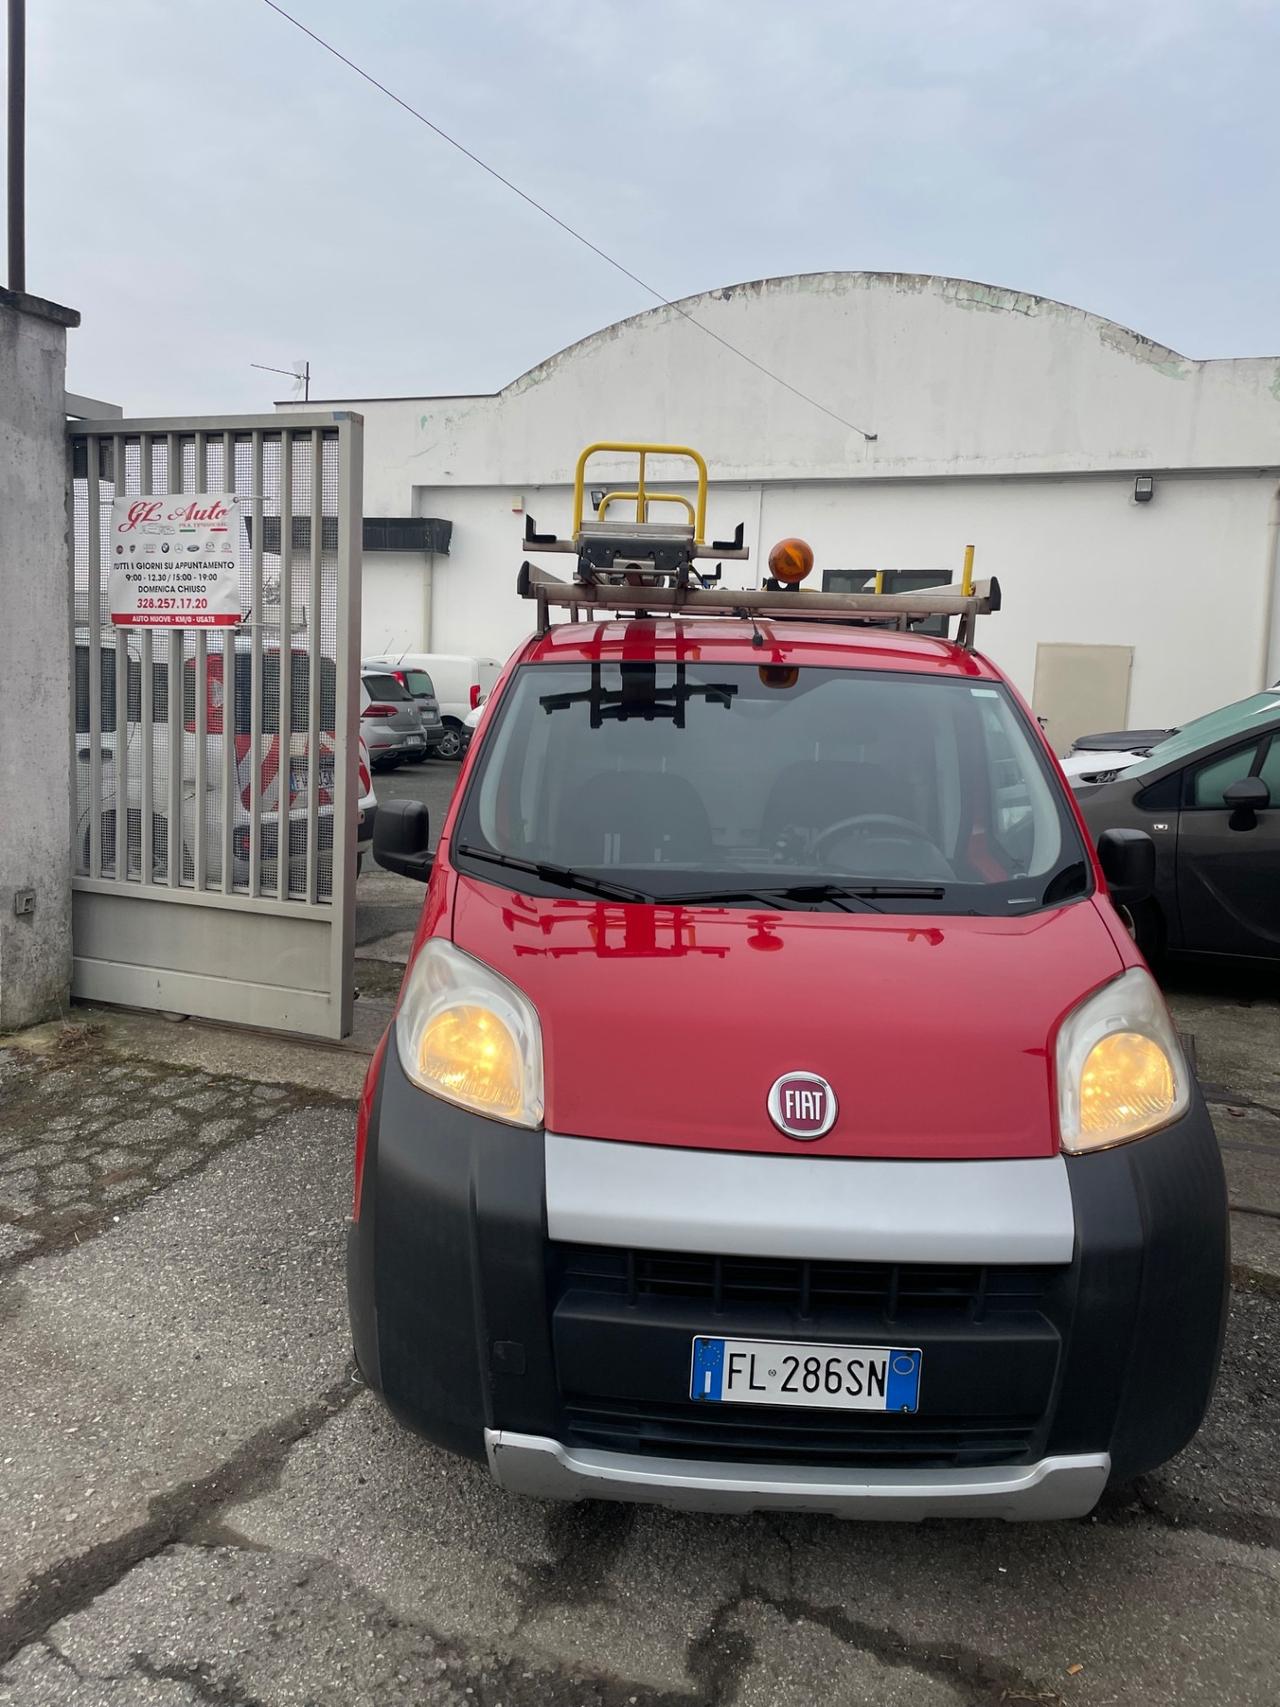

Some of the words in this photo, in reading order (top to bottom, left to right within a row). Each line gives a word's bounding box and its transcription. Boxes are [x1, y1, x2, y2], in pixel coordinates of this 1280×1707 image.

[118, 501, 163, 532] GL
[167, 501, 229, 521] Auto
[136, 562, 163, 570] GIORNI
[164, 562, 173, 570] SU
[175, 561, 235, 569] APPUNTAMENTO
[173, 573, 192, 581] 15:00
[199, 573, 218, 581] 19:00
[138, 585, 176, 593] DOMENICA
[178, 585, 207, 593] CHIUSO
[137, 598, 208, 609] 328.257.17.20
[785, 1090, 823, 1120] FIAT
[727, 1352, 766, 1391] FL
[780, 1355, 887, 1397] 286SN
